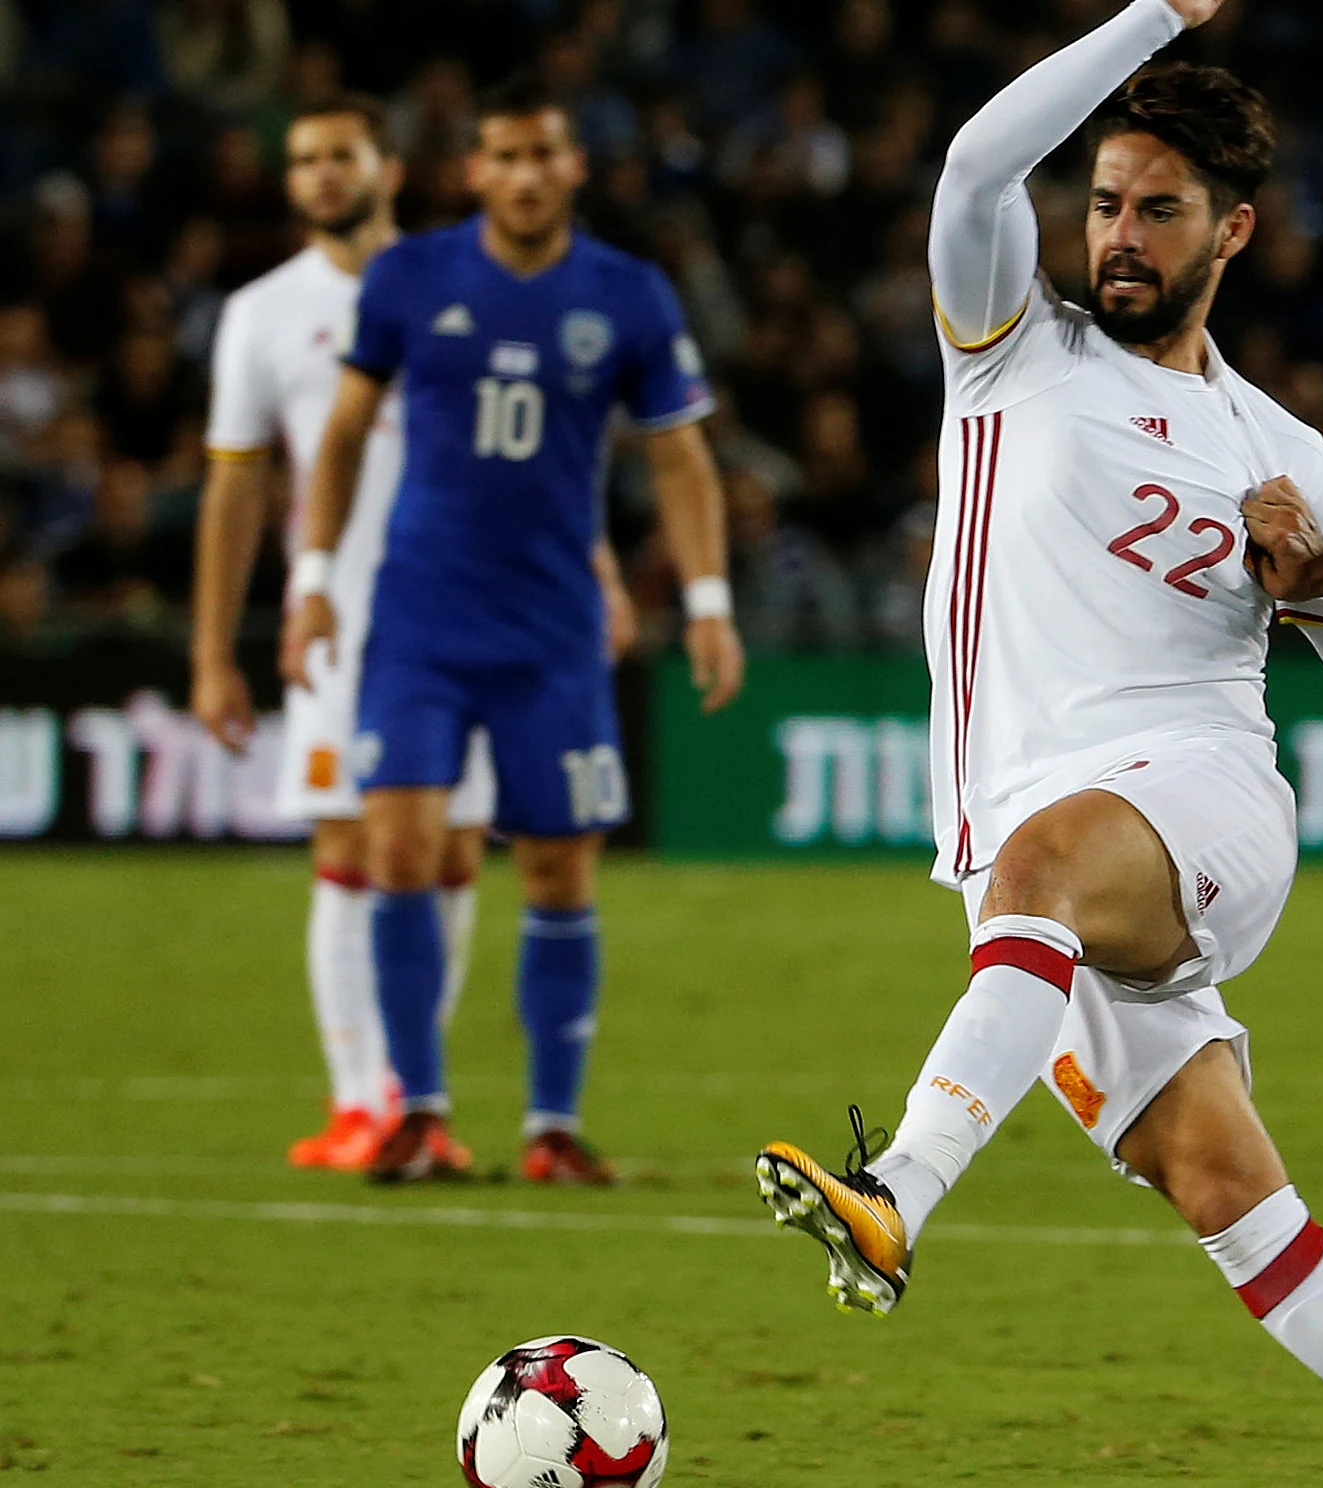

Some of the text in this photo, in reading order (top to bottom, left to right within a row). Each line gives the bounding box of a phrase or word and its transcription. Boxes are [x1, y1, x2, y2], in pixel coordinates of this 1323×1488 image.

[475, 381, 545, 462] 10
[1108, 483, 1234, 597] 22
[563, 749, 629, 825] 10
[930, 1076, 992, 1126] RFEF
